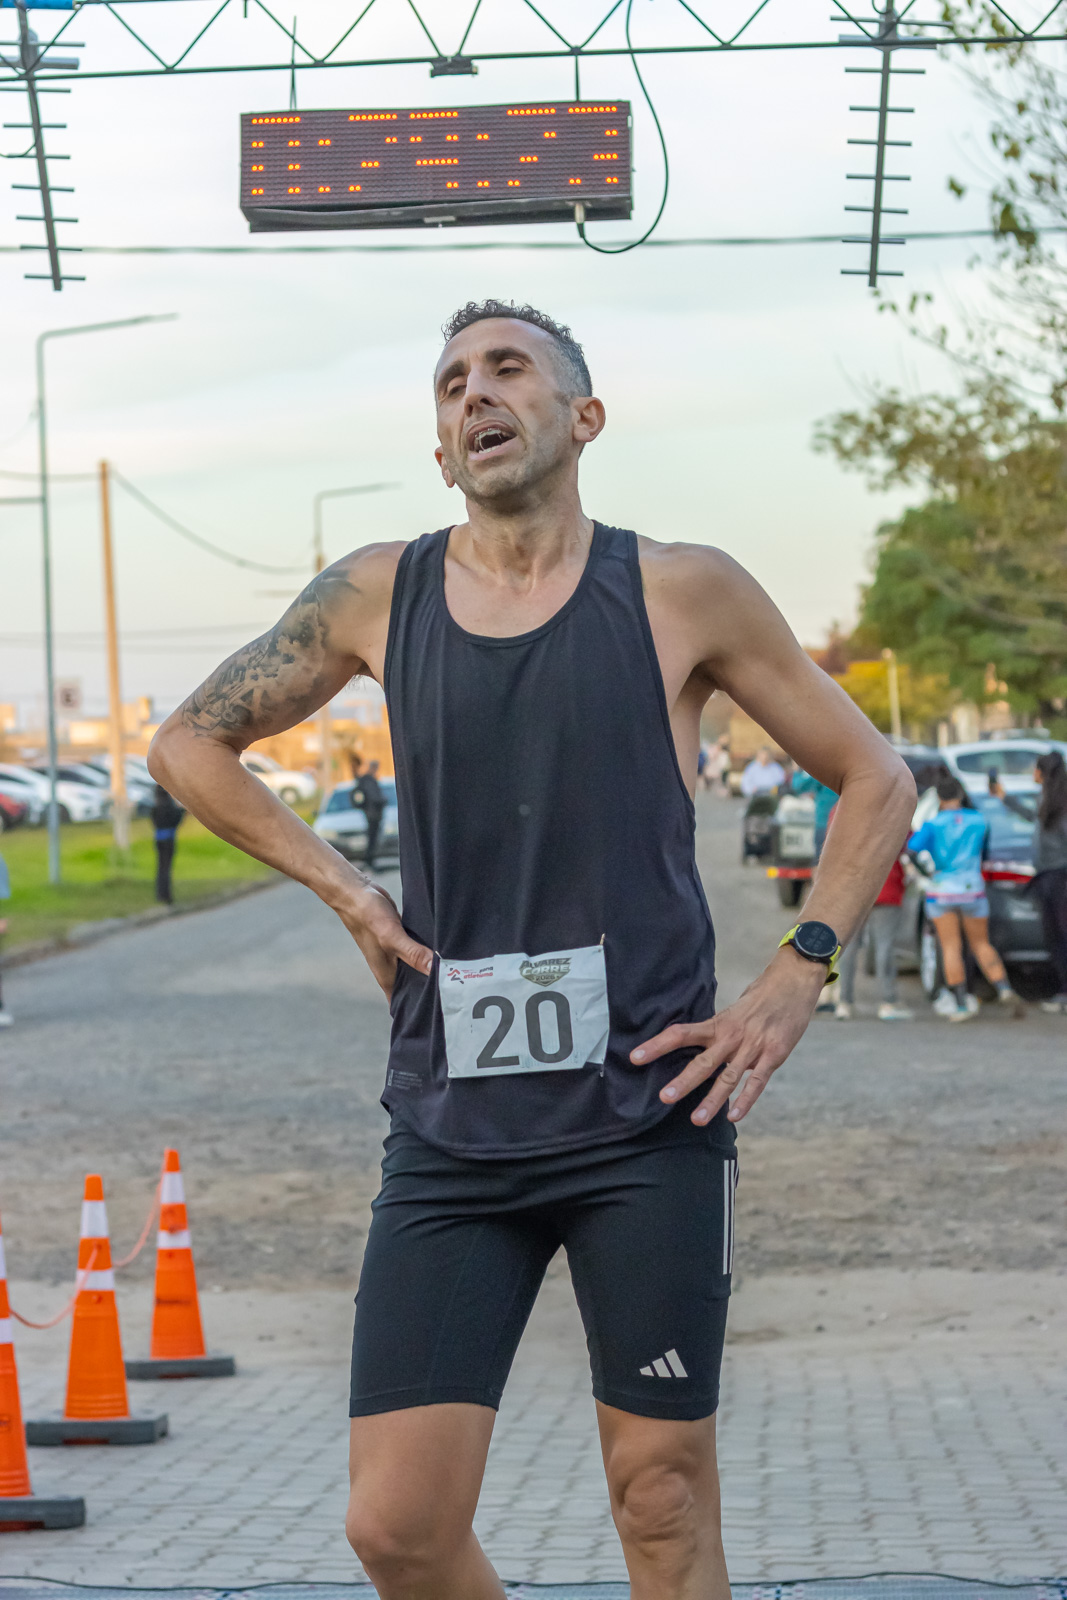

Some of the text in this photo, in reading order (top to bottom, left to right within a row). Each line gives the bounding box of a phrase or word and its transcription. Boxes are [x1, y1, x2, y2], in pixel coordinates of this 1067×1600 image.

[519, 957, 572, 969] ALVAREZ
[522, 964, 570, 976] CORRE
[472, 990, 574, 1069] 20
